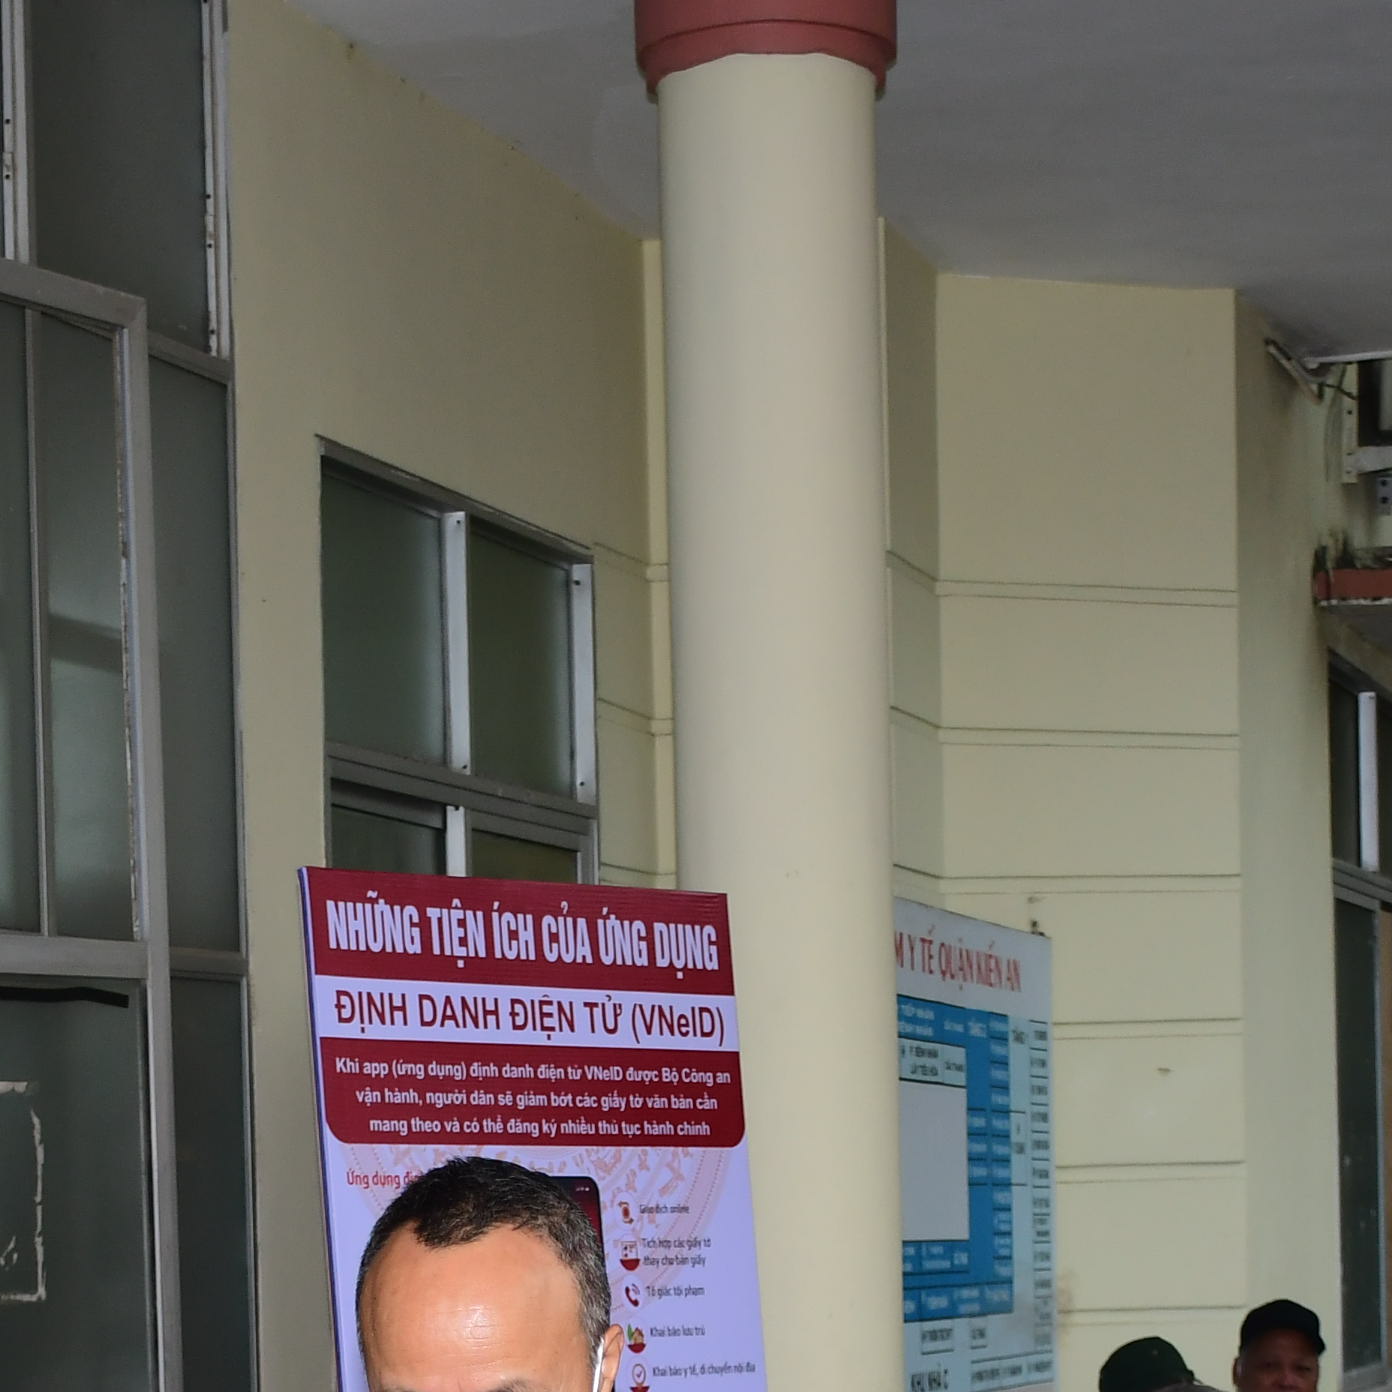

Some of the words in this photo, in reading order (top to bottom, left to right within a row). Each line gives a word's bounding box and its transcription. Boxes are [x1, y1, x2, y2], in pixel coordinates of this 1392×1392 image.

[325, 890, 421, 955] NHỮNG
[426, 898, 486, 968] TIỆN
[491, 901, 535, 961] ÍCH
[541, 901, 593, 964] CỦA
[597, 906, 649, 967] ỨNG
[653, 921, 720, 979] DỤNG
[335, 990, 407, 1034] ĐỊNH
[419, 994, 499, 1031] DANH
[510, 994, 575, 1041] ĐIỆN
[584, 994, 622, 1036] TỬ
[632, 1003, 724, 1047] (VNeID)
[335, 1056, 359, 1075] Khi
[363, 1061, 389, 1079] app
[392, 1058, 425, 1080] (ứng
[428, 1060, 467, 1081] dụng)
[470, 1061, 499, 1081] định
[502, 1062, 534, 1079] danh
[537, 1063, 564, 1083] điện
[585, 1065, 623, 1082] VNeID
[626, 1065, 659, 1085] được
[662, 1066, 679, 1086] Bộ
[682, 1068, 713, 1087] Công
[716, 1073, 731, 1084] an
[355, 1086, 381, 1107] vận
[384, 1087, 423, 1107] hành,
[426, 1088, 467, 1109] người
[470, 1089, 494, 1106] dân
[498, 1090, 513, 1106] sẽ
[516, 1091, 548, 1110] giảm
[550, 1091, 572, 1107] bớt
[576, 1092, 599, 1108] các
[601, 1090, 627, 1112] giấy
[646, 1094, 668, 1109] văn
[370, 1119, 408, 1136] mang
[411, 1116, 441, 1133] theo
[444, 1117, 461, 1133] và
[464, 1117, 480, 1133] có
[483, 1115, 504, 1134] thể
[507, 1118, 540, 1138] đăng
[542, 1118, 557, 1138] ký
[561, 1116, 595, 1135] nhiều
[621, 1119, 641, 1139] tục
[644, 1119, 675, 1136] hành
[677, 1120, 711, 1137] chính
[347, 1168, 370, 1189] Ứng
[372, 1170, 401, 1189] dụng
